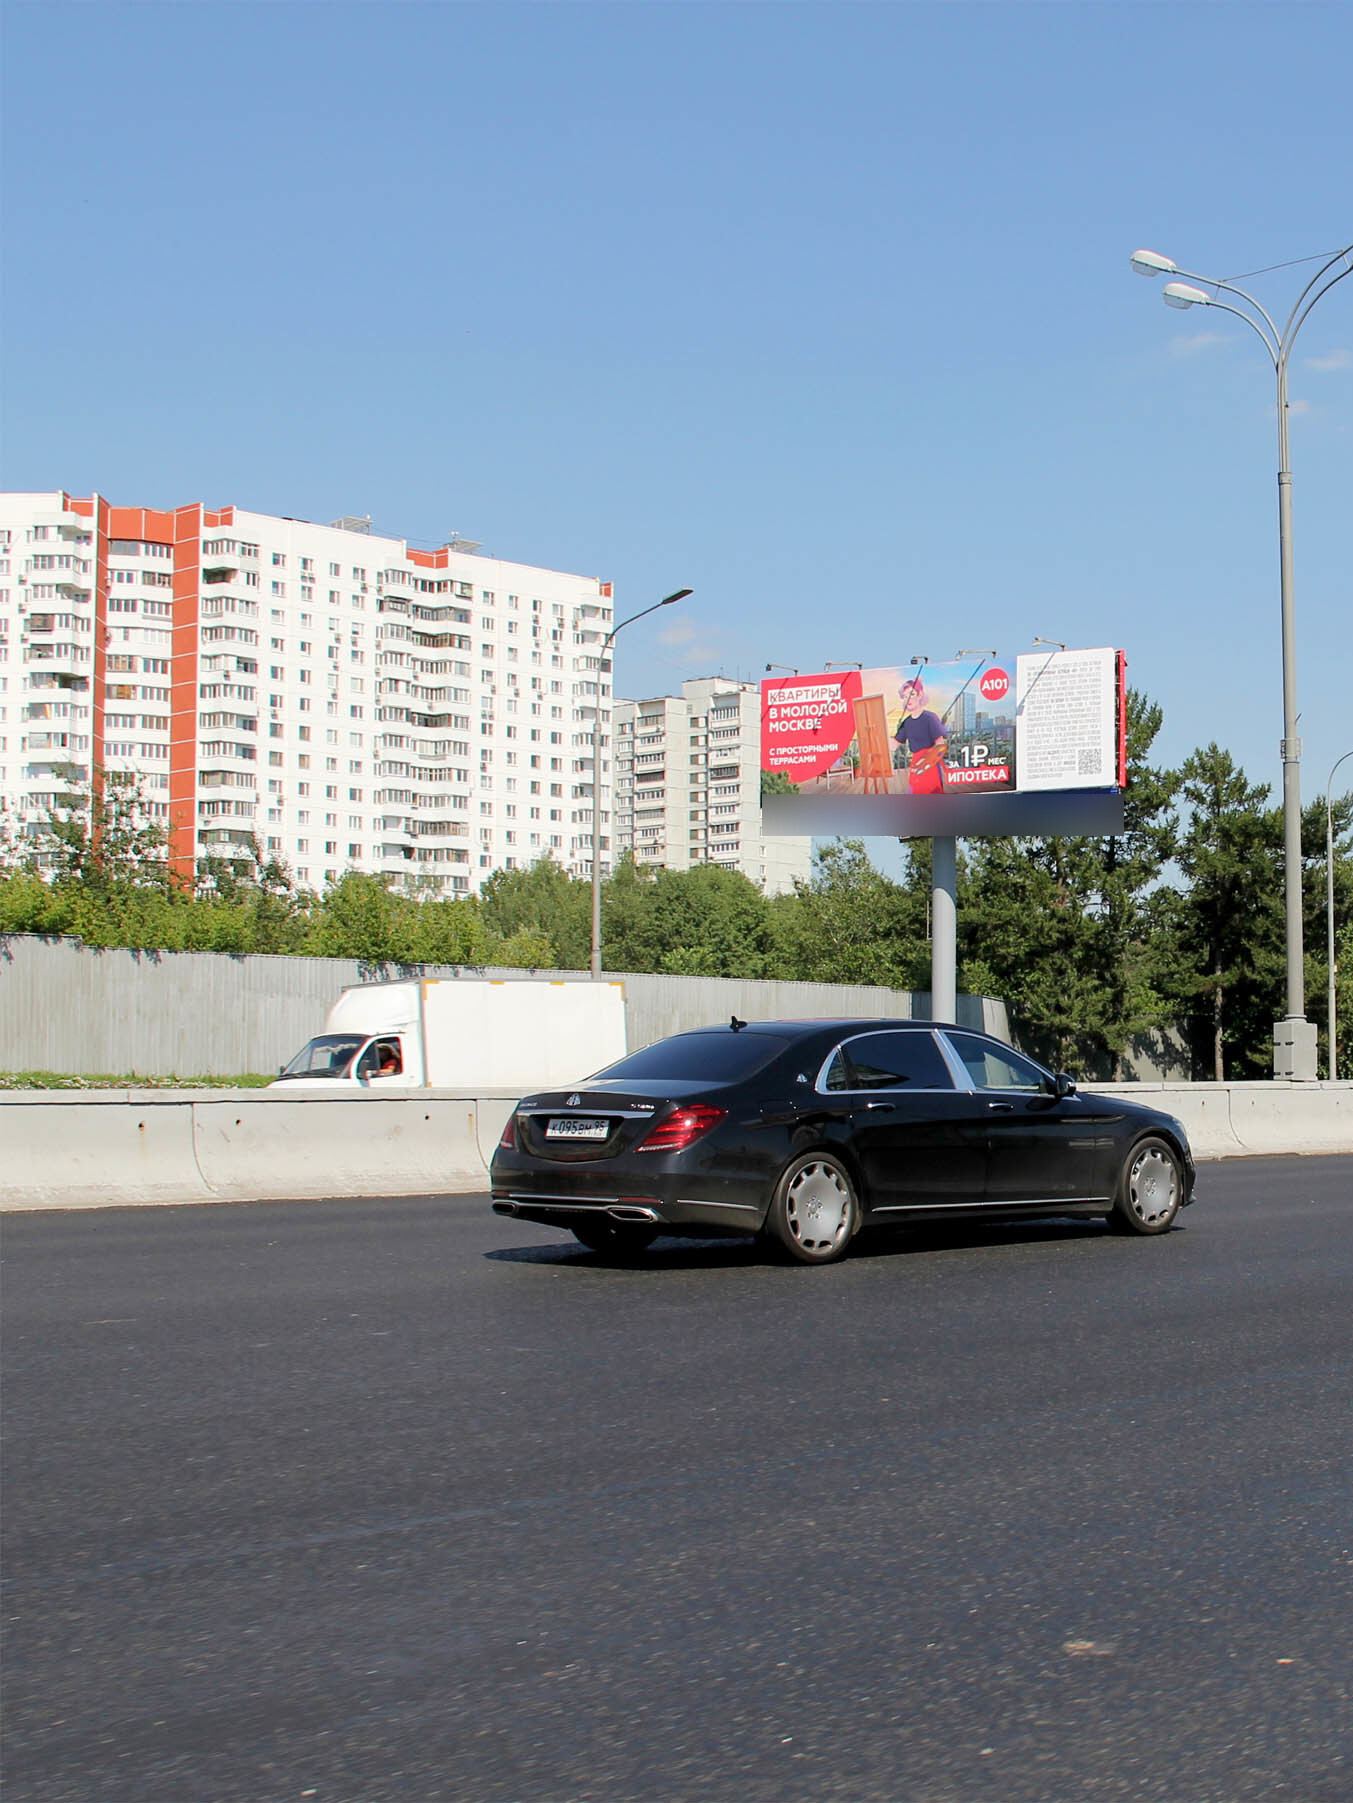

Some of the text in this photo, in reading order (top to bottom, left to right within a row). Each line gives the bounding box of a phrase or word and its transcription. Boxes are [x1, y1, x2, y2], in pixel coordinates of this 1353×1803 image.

[981, 678, 1008, 691] А101
[769, 687, 840, 702] КВАРТИРЫ
[769, 699, 848, 719] В МОЛОДОЙ
[769, 718, 822, 733] МОСКВЕ
[769, 744, 838, 756] С ПРОСТОРНЫМИ
[769, 755, 816, 766] ТЕРРАСАМИ
[948, 760, 960, 768] ЗА
[987, 757, 1006, 766] МЕС
[948, 769, 1007, 783] ИПОТЕКА
